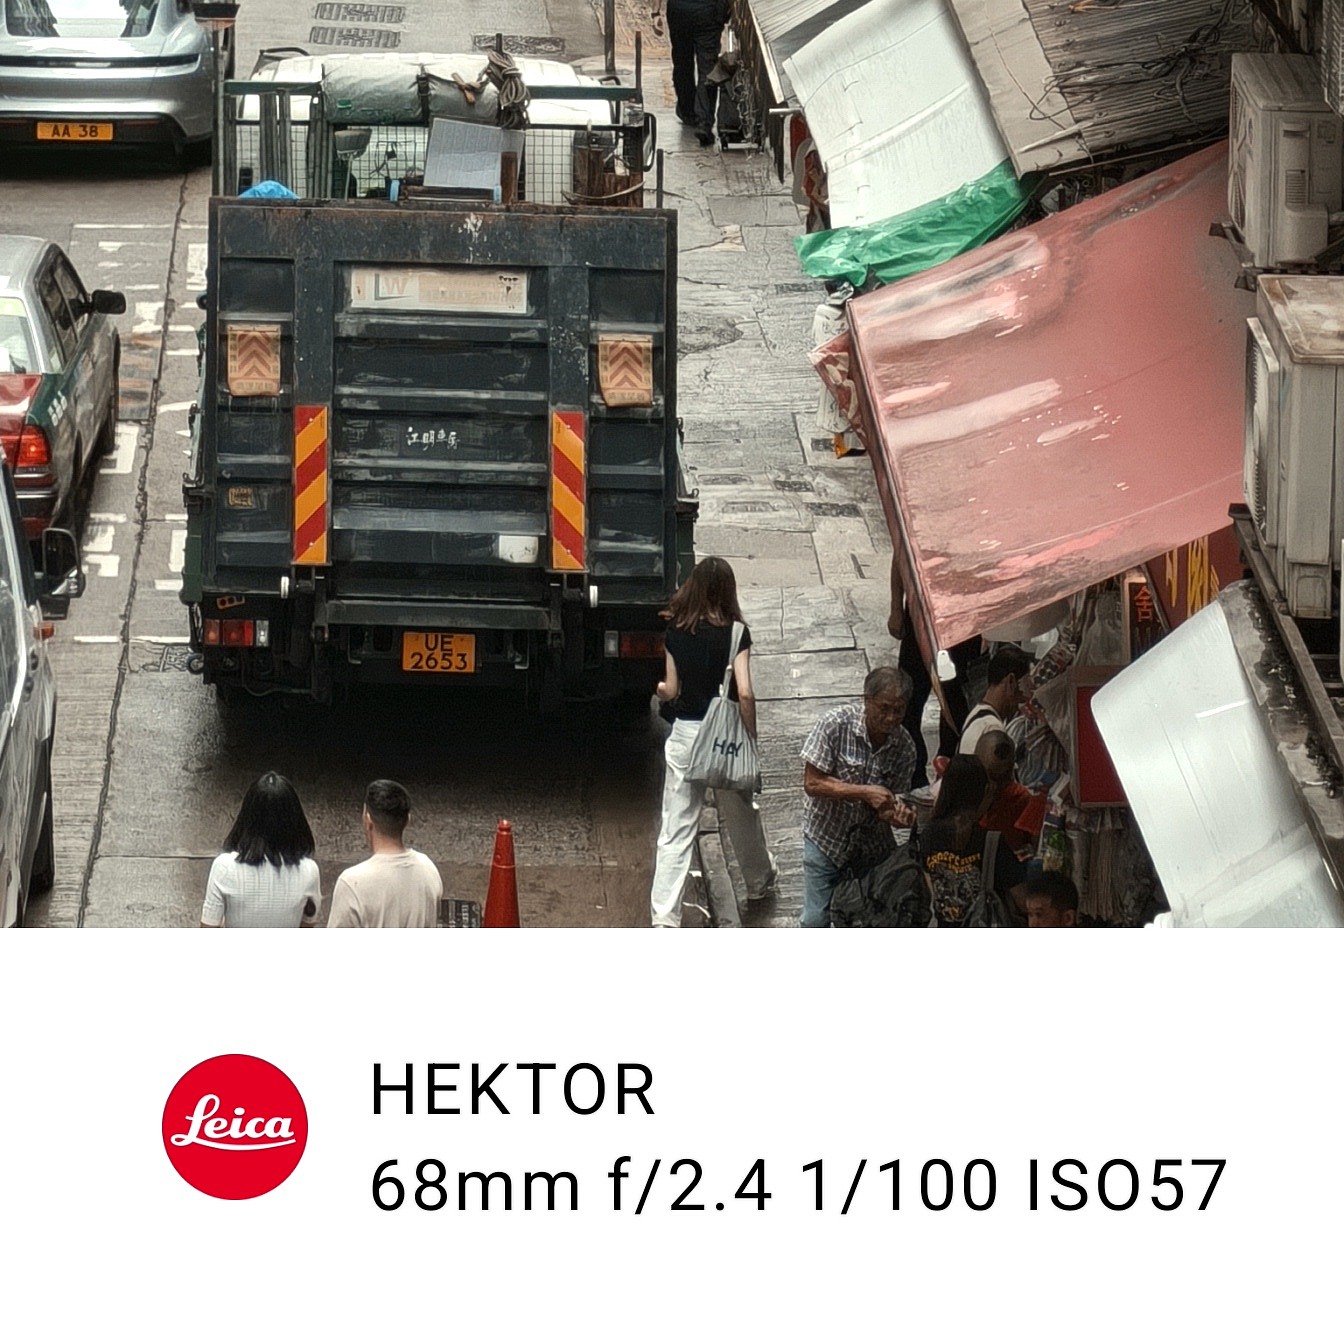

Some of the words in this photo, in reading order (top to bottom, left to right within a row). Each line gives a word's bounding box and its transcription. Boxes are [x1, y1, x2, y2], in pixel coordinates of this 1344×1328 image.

[51, 125, 71, 137] AA
[78, 125, 99, 138] 38
[424, 633, 455, 652] UE
[410, 651, 468, 671] 2653
[712, 737, 743, 757] HAY
